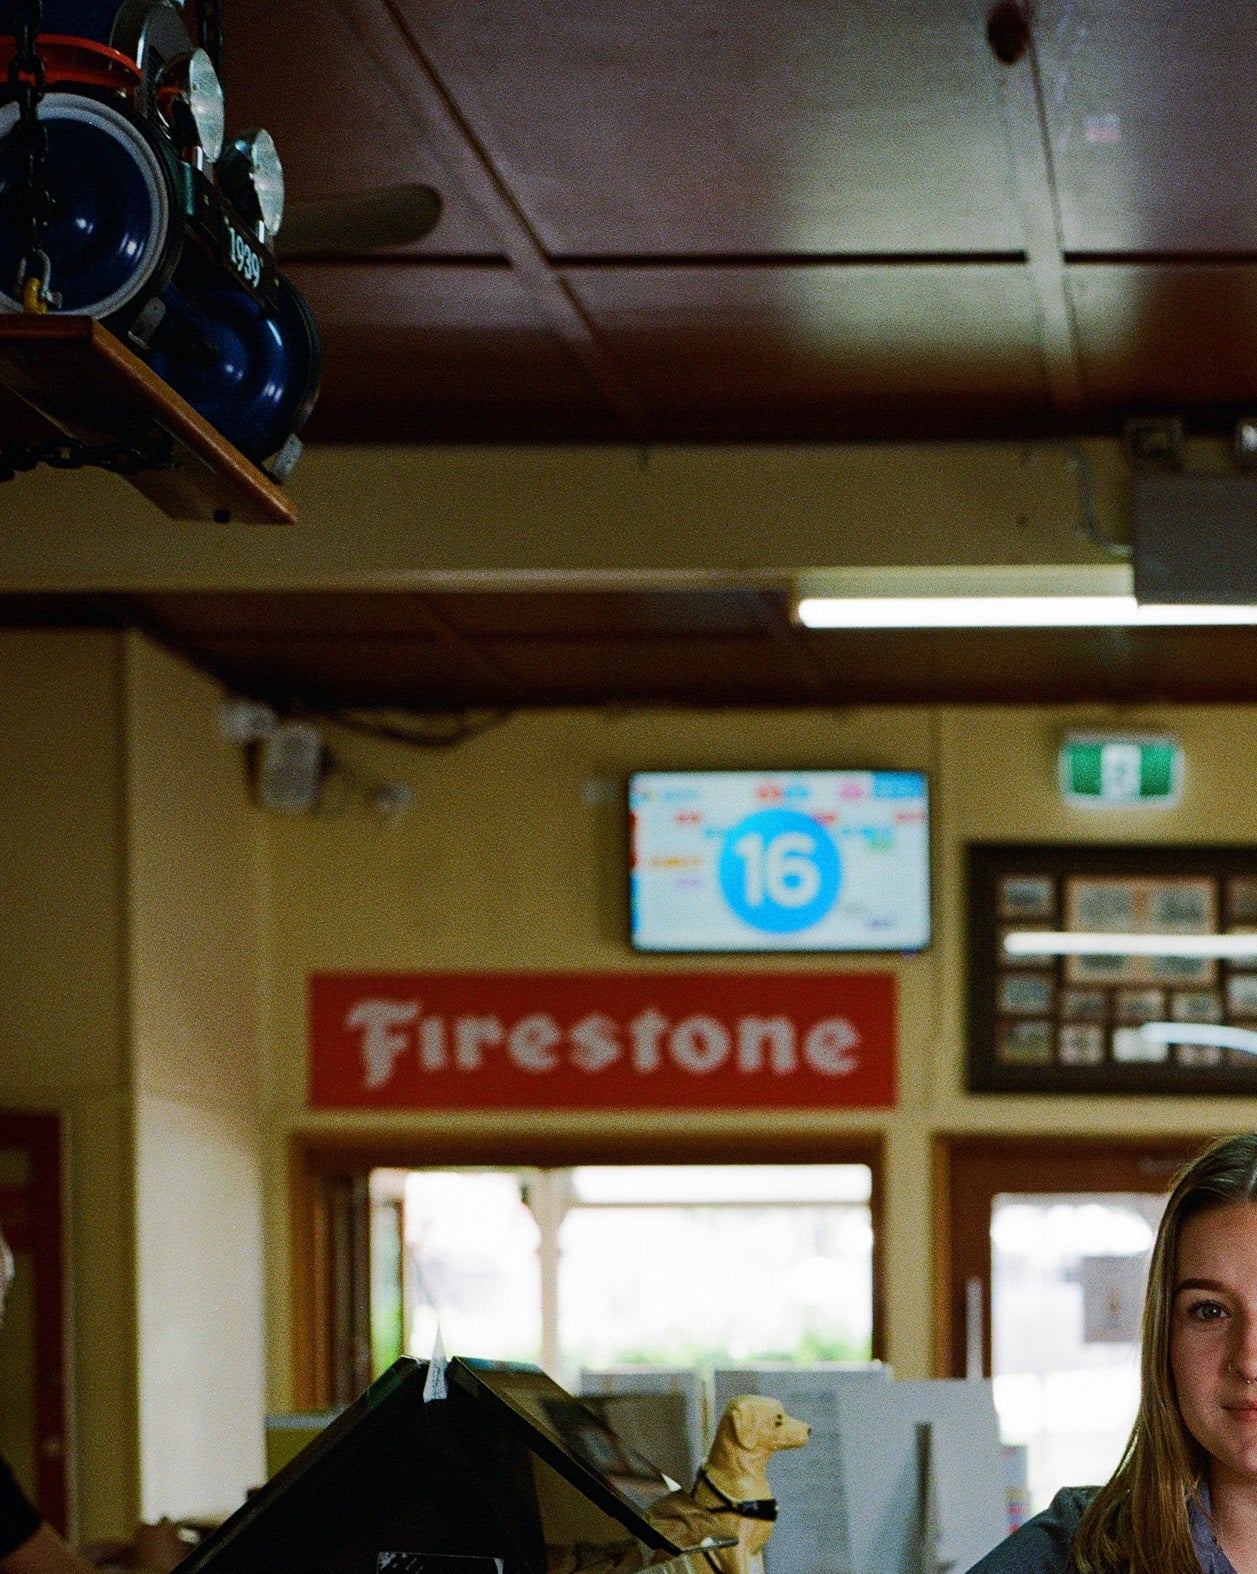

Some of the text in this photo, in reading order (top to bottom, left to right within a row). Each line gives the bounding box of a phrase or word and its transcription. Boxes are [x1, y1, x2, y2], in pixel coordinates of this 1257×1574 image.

[228, 227, 261, 288] 1939
[735, 832, 822, 908] 16
[346, 1000, 862, 1090] Firestone
